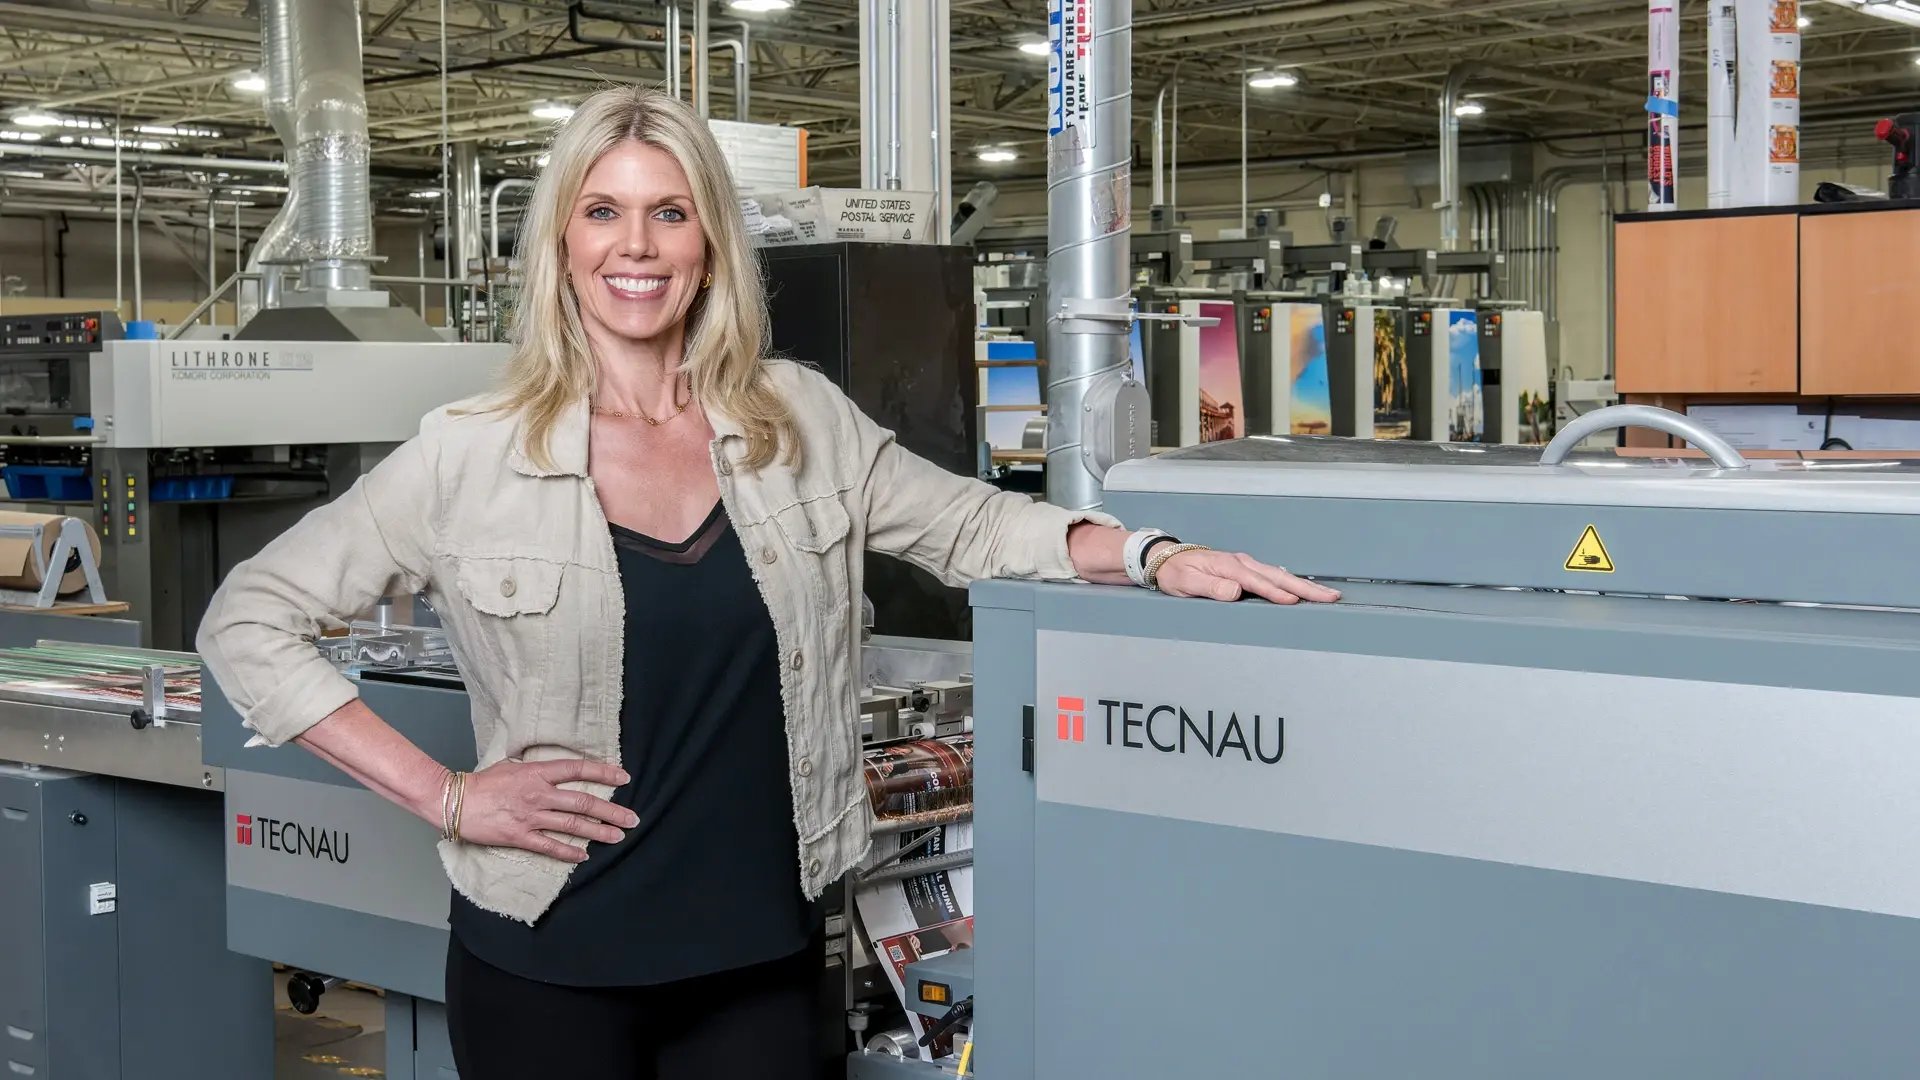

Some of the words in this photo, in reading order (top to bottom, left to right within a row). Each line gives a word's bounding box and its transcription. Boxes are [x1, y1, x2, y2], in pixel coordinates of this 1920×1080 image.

[1066, 16, 1074, 47] THE
[1066, 50, 1074, 80] ARE
[1066, 86, 1074, 117] YOU
[841, 212, 876, 222] POSTAL
[879, 213, 915, 223] SERVICE
[846, 198, 877, 209] UNITED
[880, 200, 910, 210] STATES
[172, 351, 270, 366] LITHRONE
[172, 371, 206, 380] KOMORI
[210, 371, 270, 380] CORPORATION
[1098, 699, 1284, 764] TECNAU
[257, 817, 348, 863] TECNAU
[939, 884, 955, 913] DUNN
